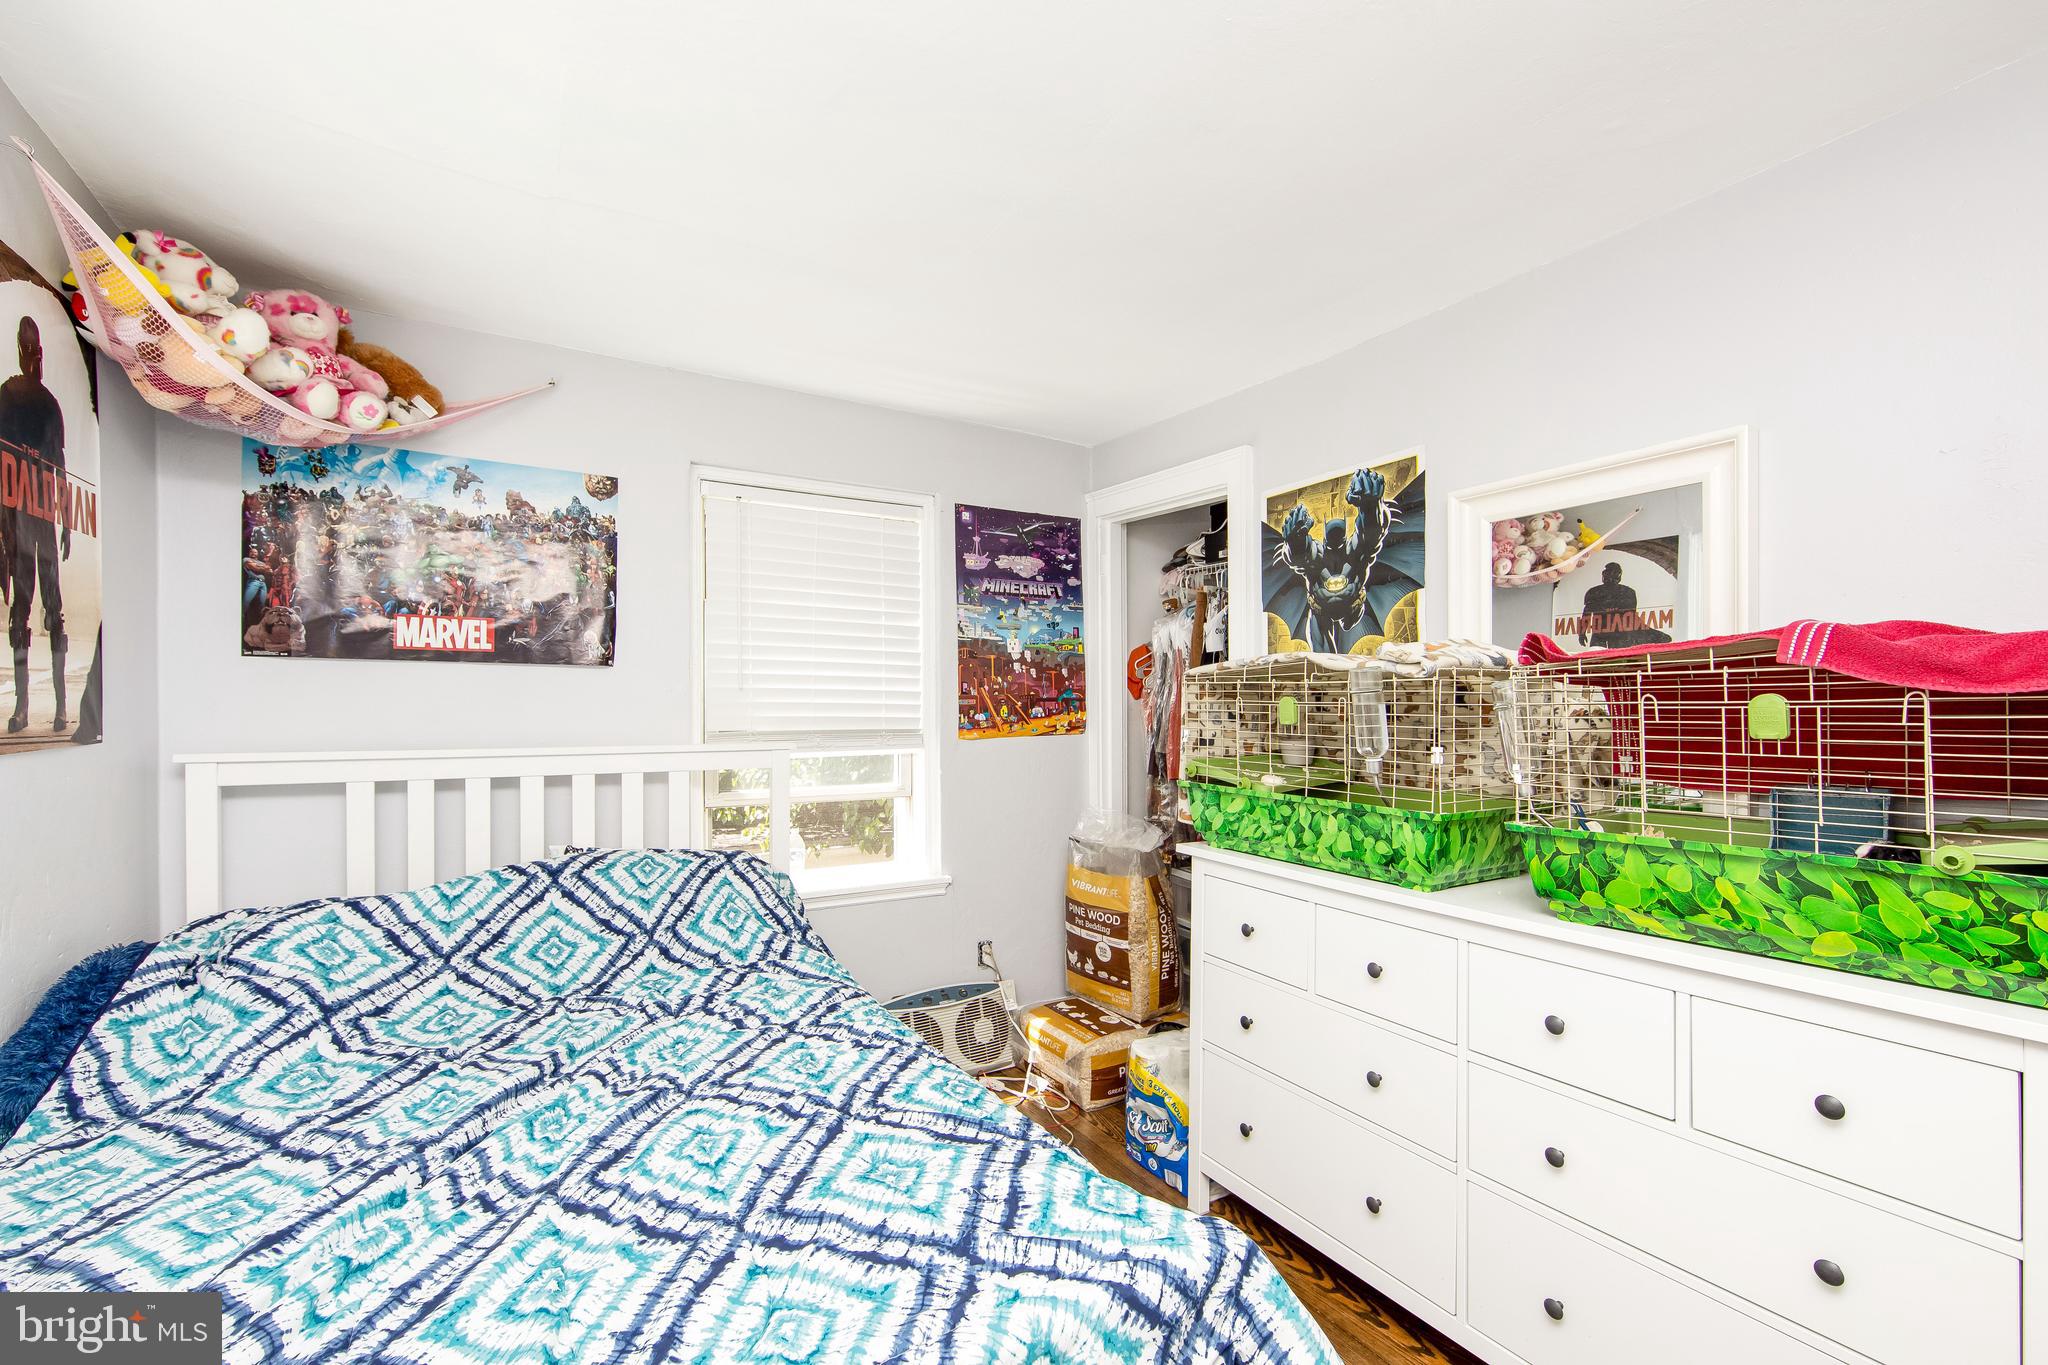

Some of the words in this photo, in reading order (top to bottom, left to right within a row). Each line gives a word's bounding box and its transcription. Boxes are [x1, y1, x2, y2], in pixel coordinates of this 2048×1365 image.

[22, 443, 41, 459] THE
[1, 450, 97, 538] DALORIAN
[981, 577, 1063, 597] MINECRAFT
[395, 616, 493, 650] MARVEL
[1068, 903, 1086, 917] PINE
[1087, 909, 1121, 926] WOOD
[1075, 916, 1084, 927] Pet
[1085, 920, 1111, 936] Bedding
[1161, 950, 1171, 980] PINE
[1148, 1079, 1153, 1088] 3
[1141, 1116, 1168, 1133] Scott
